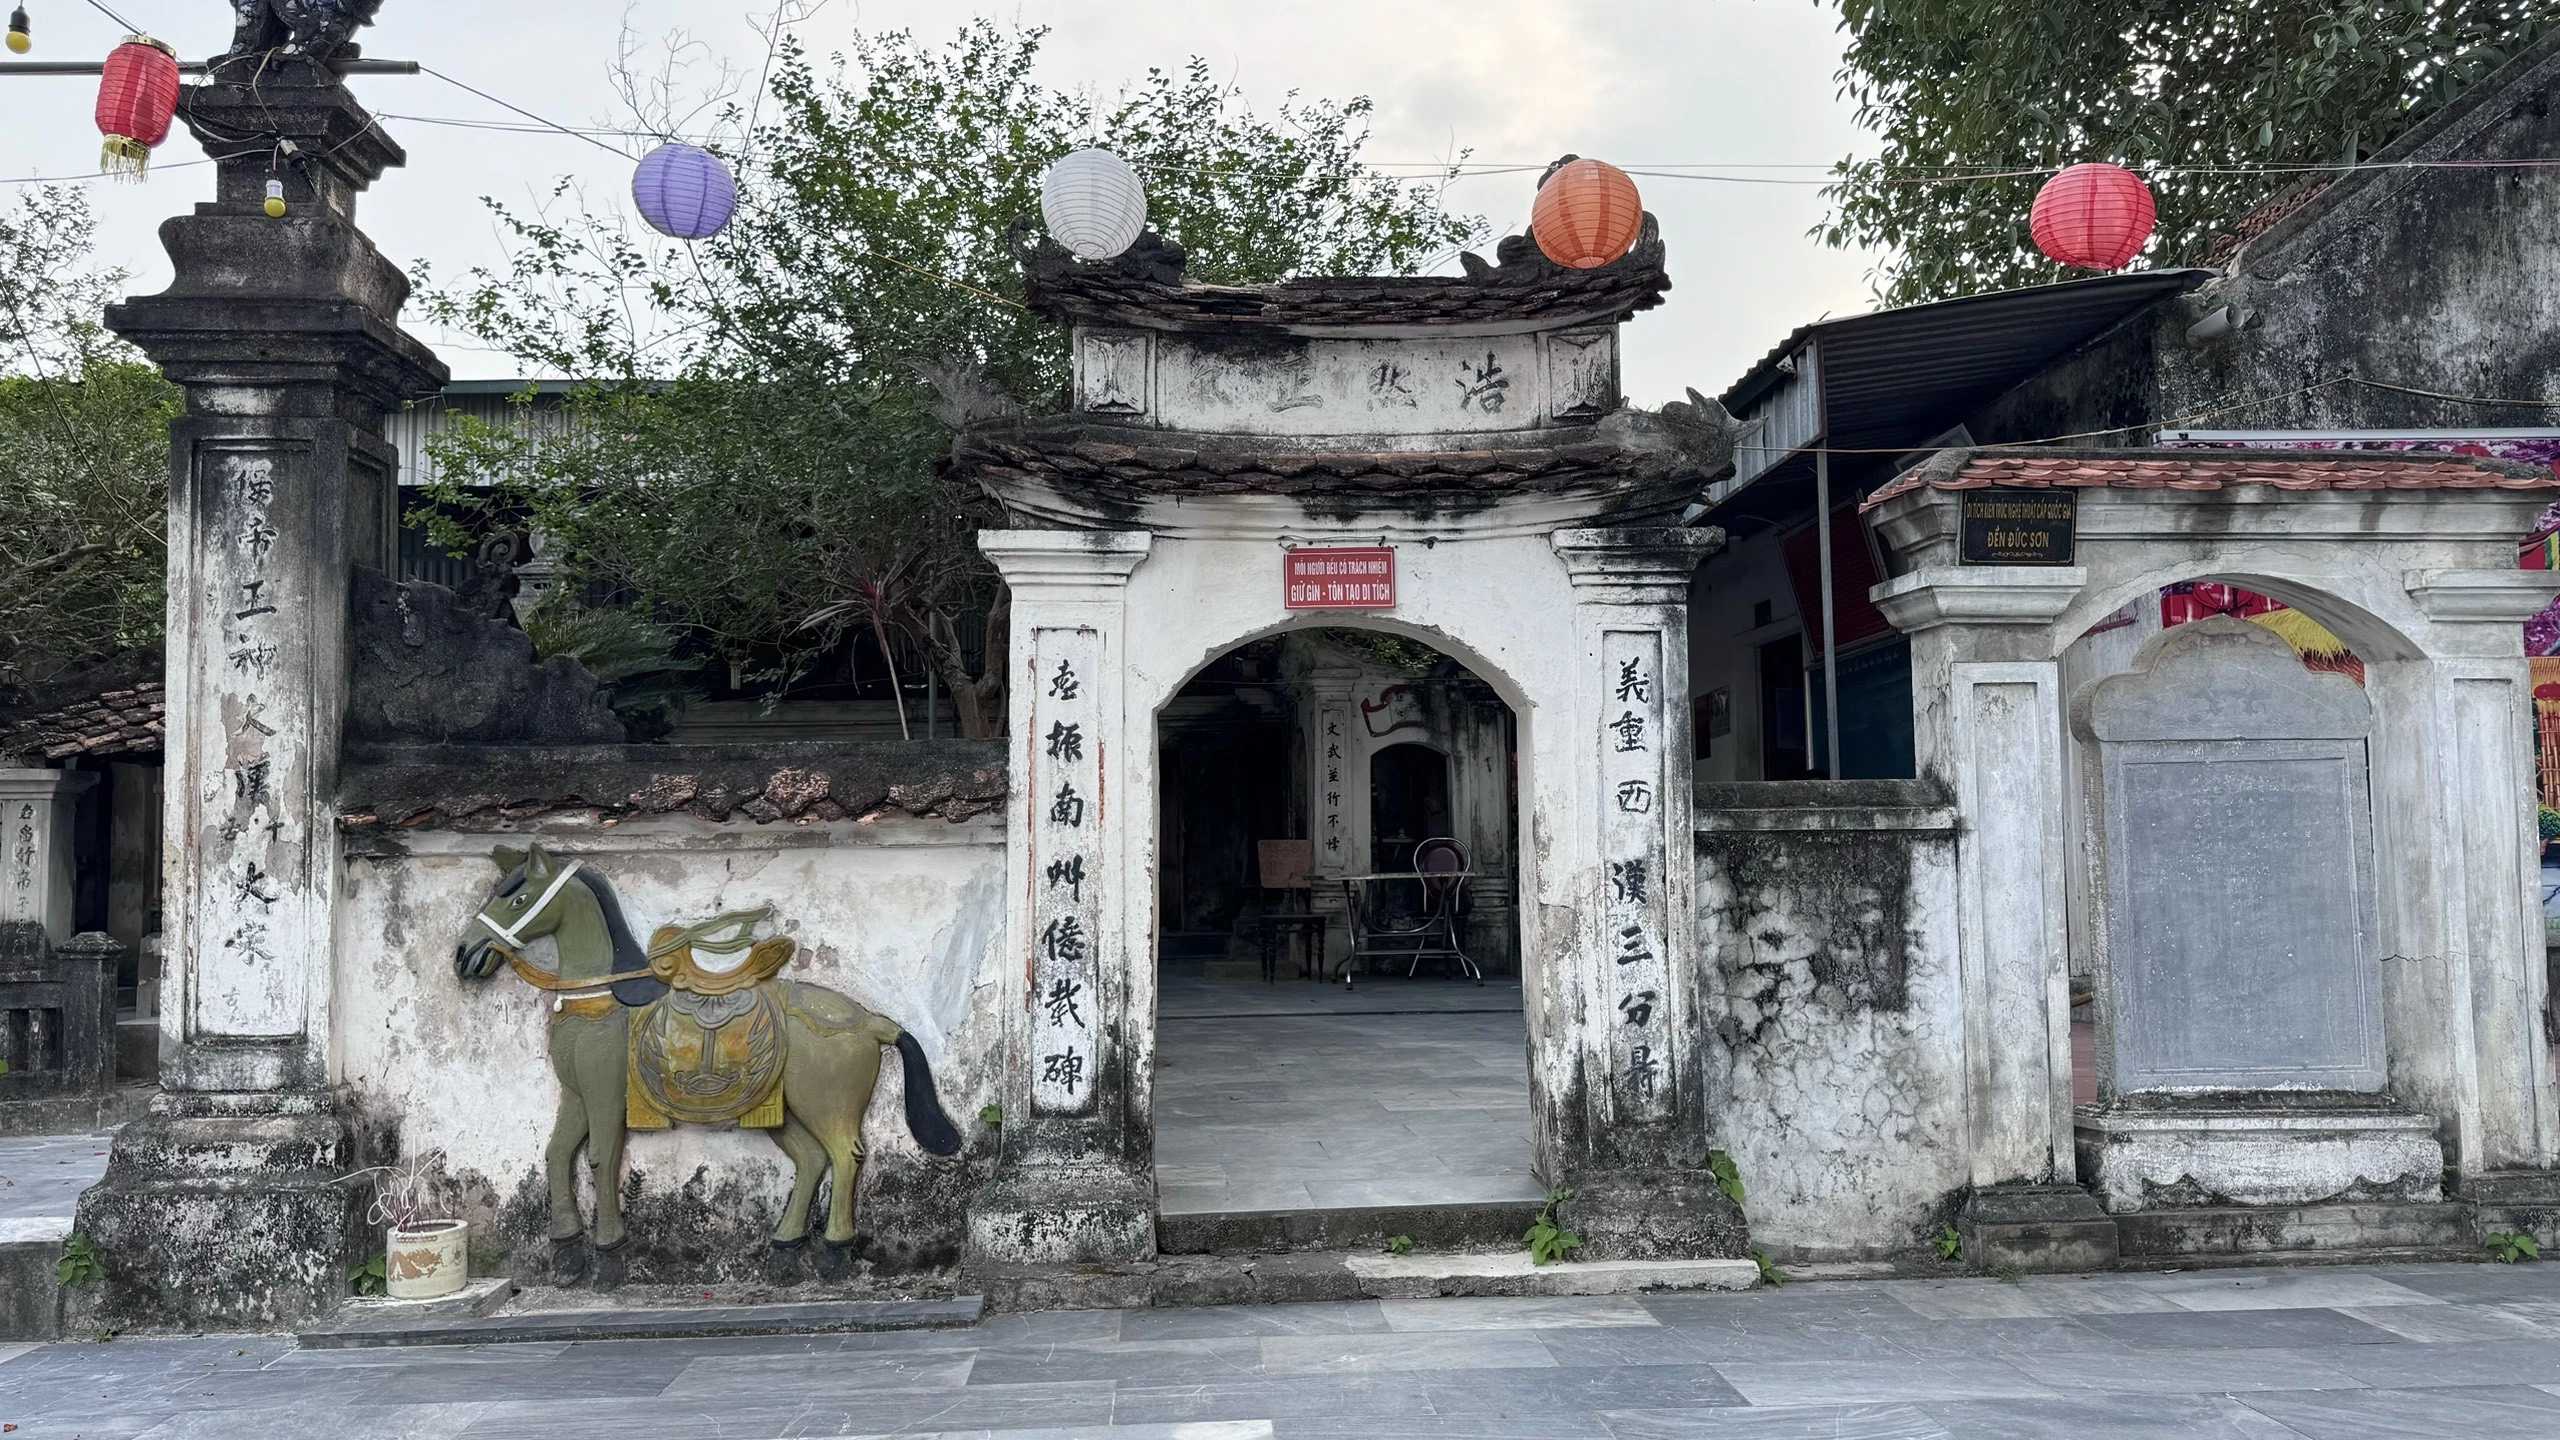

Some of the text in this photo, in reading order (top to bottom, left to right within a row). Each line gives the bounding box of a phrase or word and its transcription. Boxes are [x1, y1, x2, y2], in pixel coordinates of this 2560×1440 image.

[2008, 527, 2028, 548] ĐỨC
[2030, 531, 2050, 548] SƠN
[1339, 558, 1347, 575] CÓ
[1348, 558, 1367, 575] TRÁCH
[1368, 558, 1387, 577] NHIỆM
[1291, 580, 1305, 602] GIỮ
[1306, 580, 1320, 602] GÌN
[1328, 580, 1343, 601] TÔN
[1345, 583, 1360, 604] TẠO
[1362, 583, 1371, 601] DI
[1372, 579, 1390, 601] TÍCH
